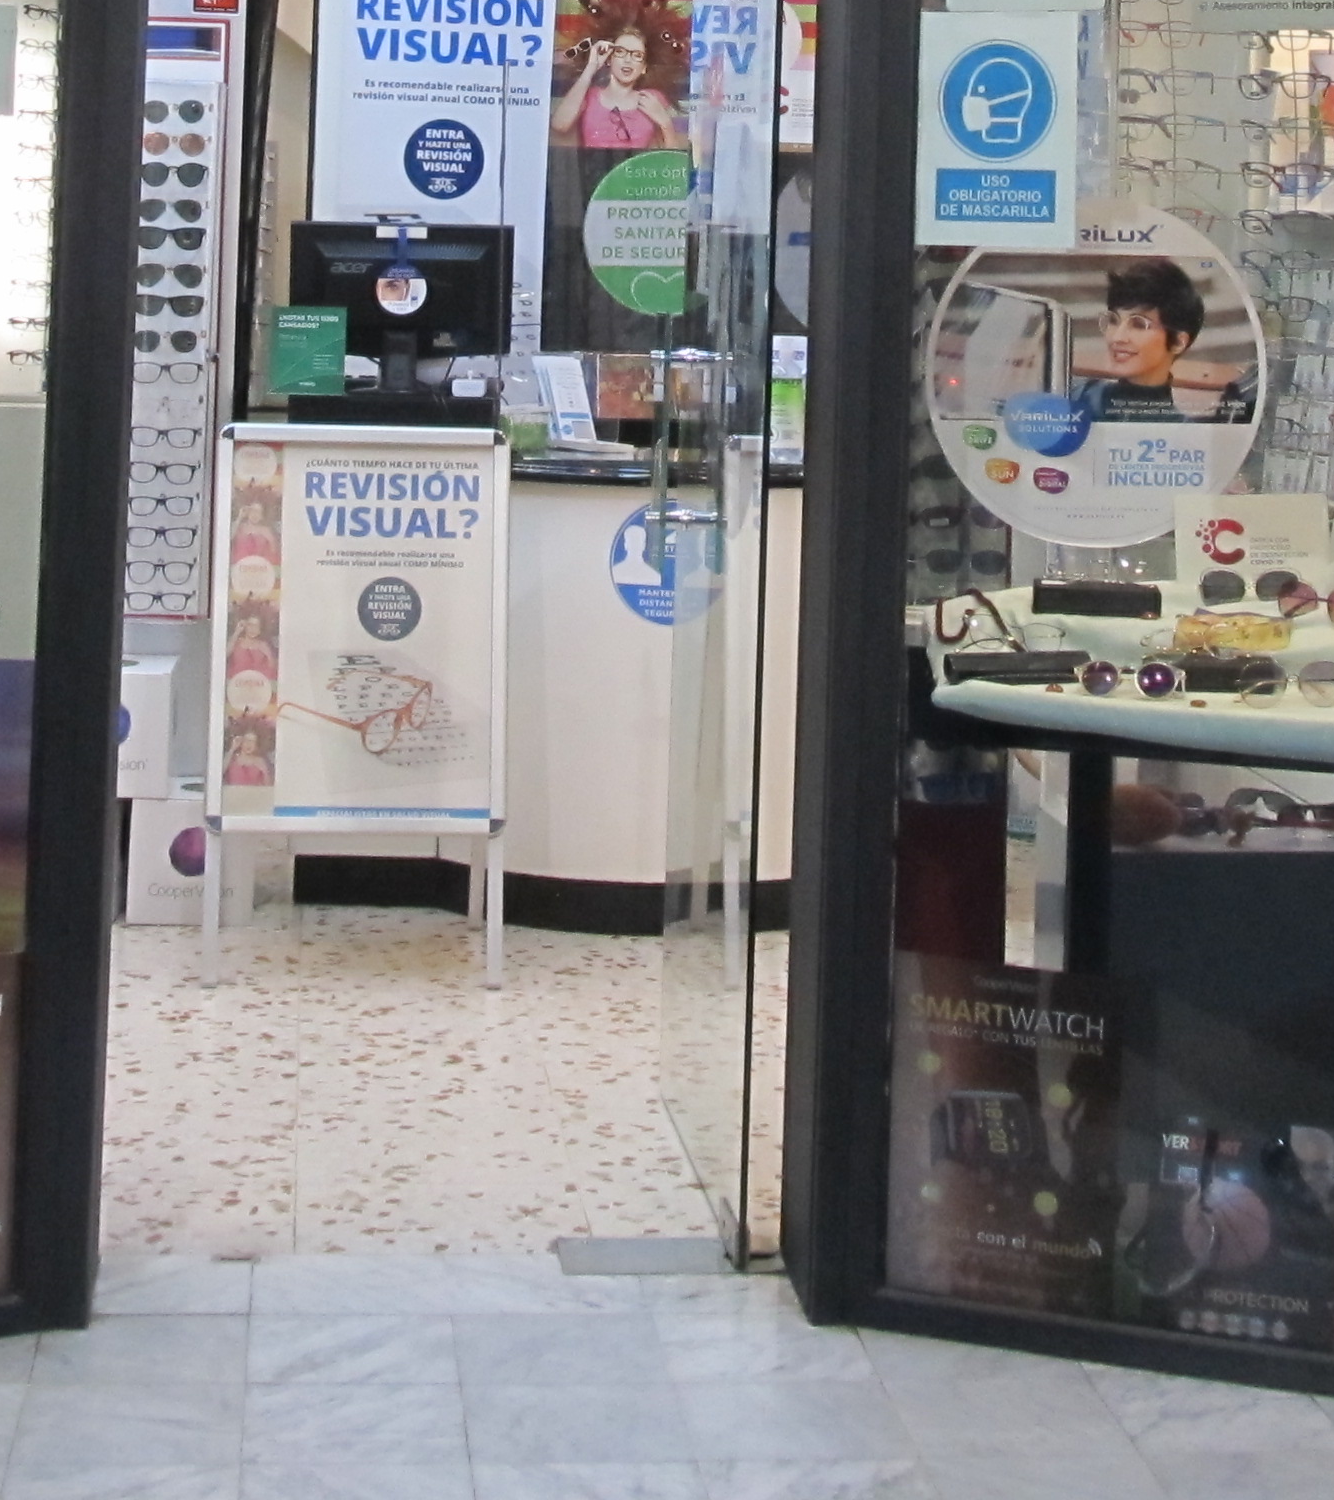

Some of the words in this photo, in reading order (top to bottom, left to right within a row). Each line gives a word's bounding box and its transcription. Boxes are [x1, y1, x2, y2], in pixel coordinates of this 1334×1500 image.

[357, 27, 543, 68] VISUAL?
[416, 148, 472, 162] REVISIÓN
[949, 189, 1041, 202] OBLIGATORIO
[940, 204, 958, 216] DE
[962, 204, 1050, 217] MASCARILLA
[330, 262, 373, 274] acer
[1108, 449, 1132, 462] TU
[1169, 450, 1204, 463] PAR
[305, 470, 480, 502] REVISIÓN
[1108, 472, 1204, 487] INCLUIDO
[305, 506, 479, 539] VISUAL?
[910, 994, 1104, 1040] SMARTWATCH
[982, 1031, 1009, 1043] CON
[1013, 1033, 1036, 1047] TUS
[977, 1229, 1005, 1246] con
[1011, 1233, 1026, 1250] el
